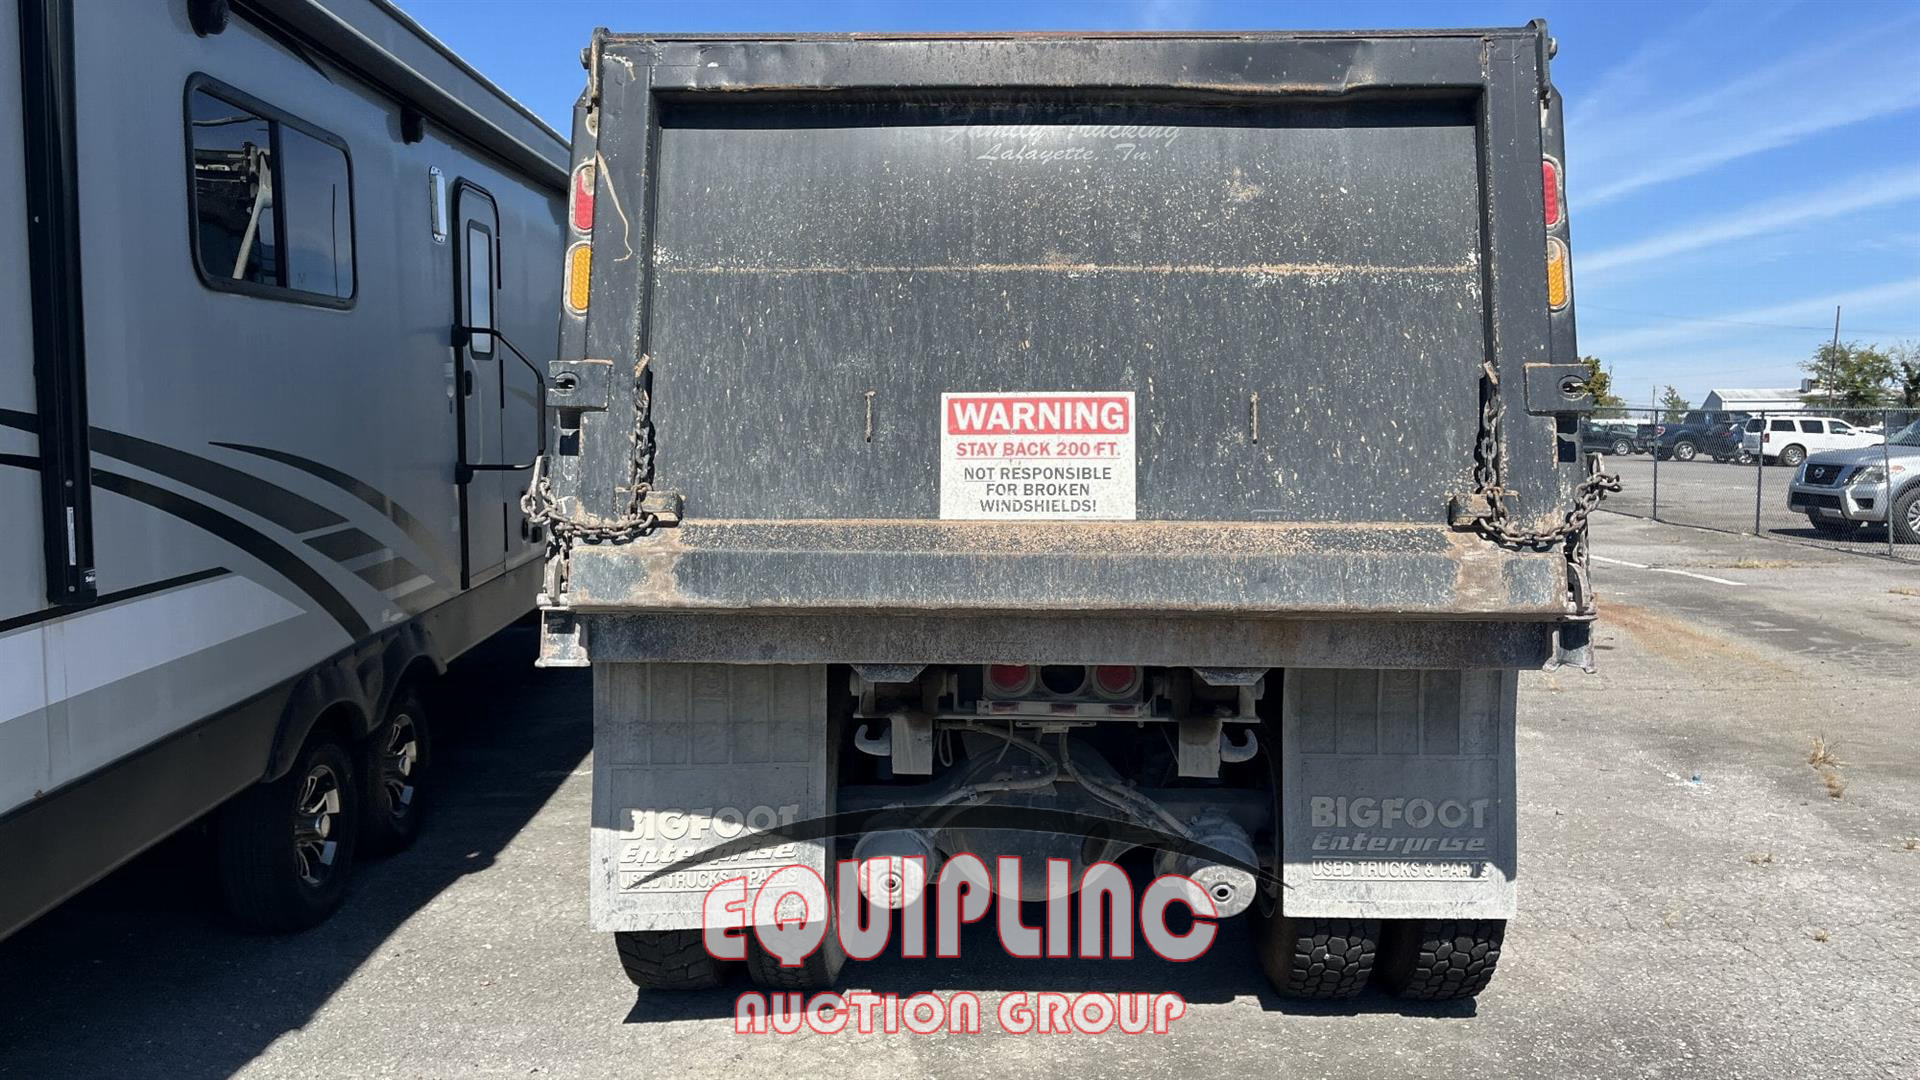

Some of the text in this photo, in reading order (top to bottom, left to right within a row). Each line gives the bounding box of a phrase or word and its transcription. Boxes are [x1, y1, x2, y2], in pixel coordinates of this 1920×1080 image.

[953, 401, 1125, 431] WARNING
[957, 442, 1121, 456] STAY BACK 200 FT.
[964, 467, 1112, 480] NOT RESPONSIBLE
[986, 483, 1090, 496] FOR BROKEN
[980, 500, 1097, 512] WINDSHIELDS!
[1311, 796, 1489, 829] BIGFOOT
[619, 805, 799, 841] BIGFOOT
[1312, 832, 1486, 855] Enterprise
[1312, 861, 1489, 879] USED TRUCKS & PARTS
[668, 870, 730, 889] TRUCKS
